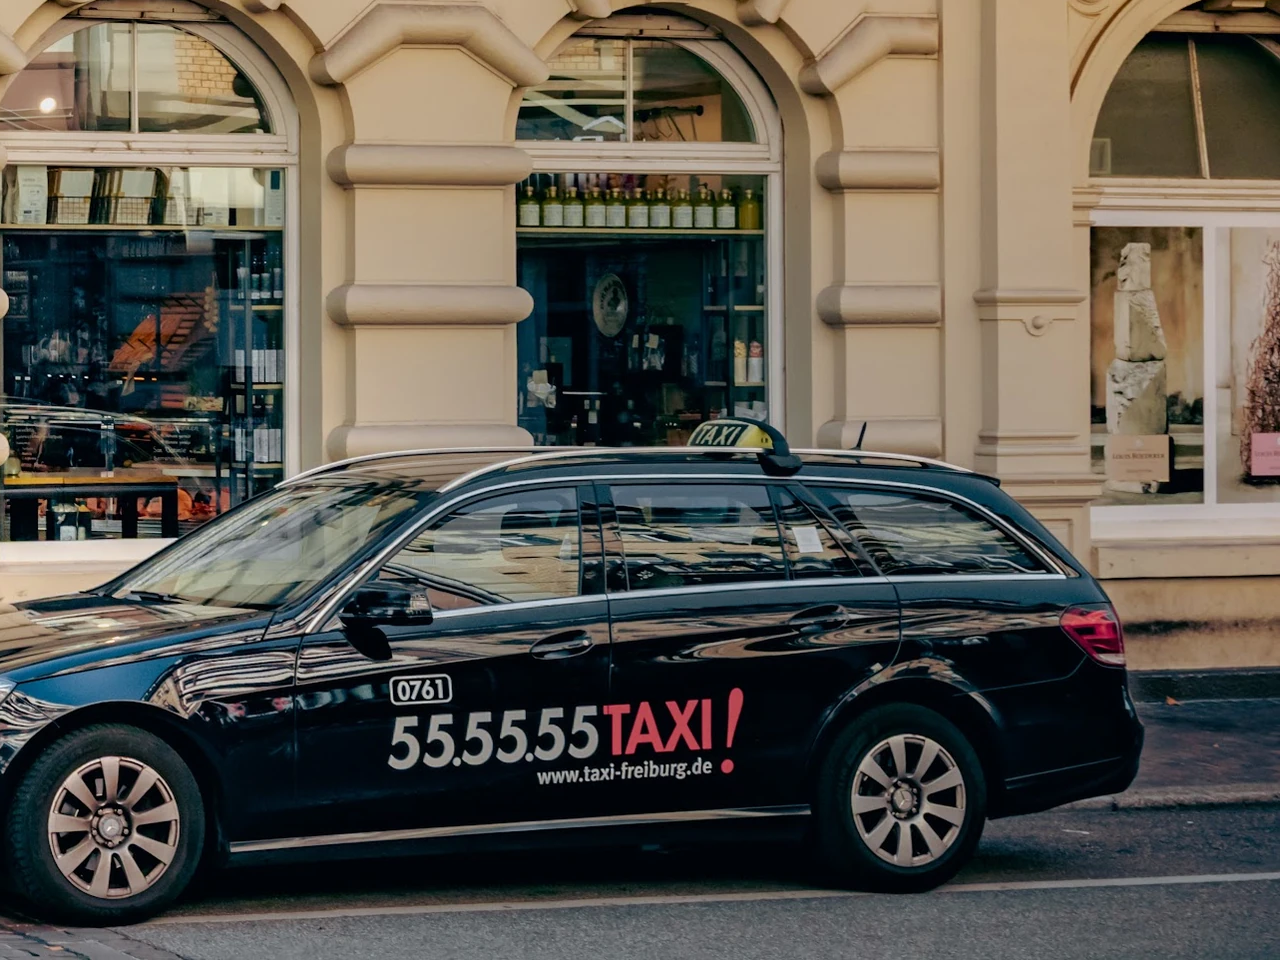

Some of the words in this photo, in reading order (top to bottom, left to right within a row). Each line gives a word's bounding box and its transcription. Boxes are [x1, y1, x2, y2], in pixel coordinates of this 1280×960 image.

[695, 425, 742, 445] TAXI
[396, 678, 446, 702] 0761
[537, 760, 713, 785] www.taxi-freiburg.de
